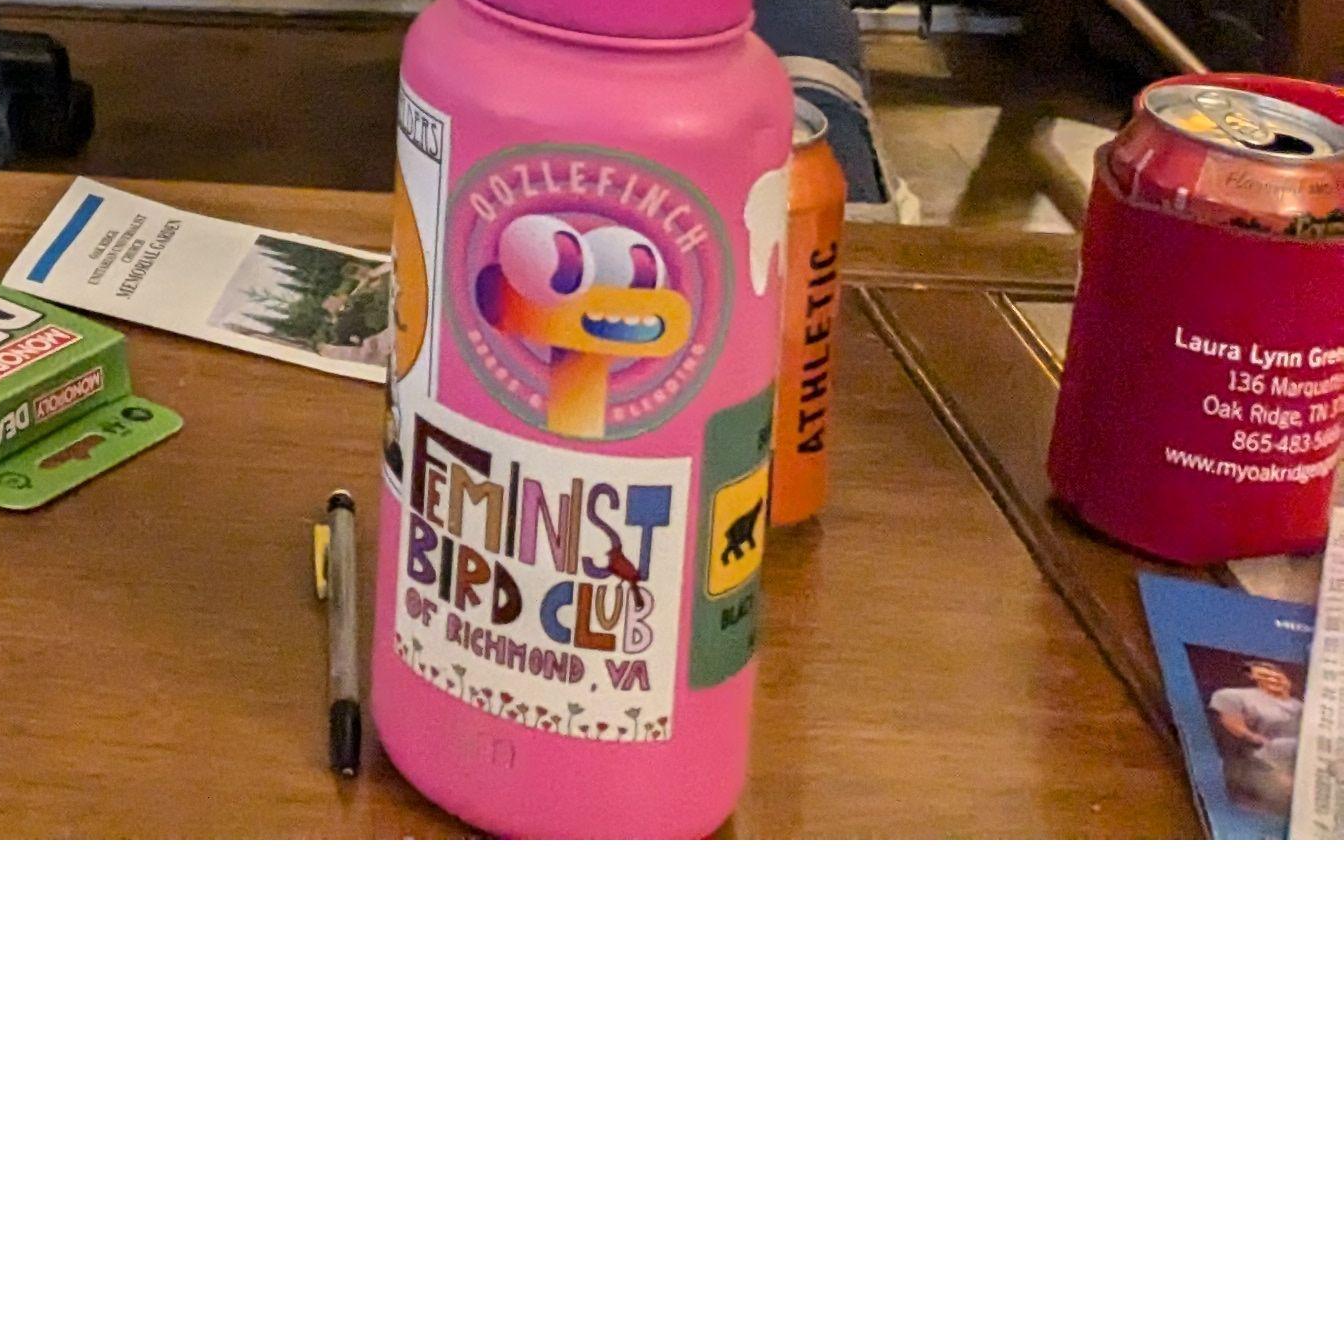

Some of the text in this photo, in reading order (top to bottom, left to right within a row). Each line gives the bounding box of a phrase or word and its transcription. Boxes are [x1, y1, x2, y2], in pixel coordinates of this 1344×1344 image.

[470, 162, 708, 254] OOZLEFINCH
[115, 218, 183, 299] MEMORIAL GARDEN
[796, 240, 838, 456] ATHLETIC
[1175, 325, 1242, 362] Laura
[1250, 342, 1303, 370] Lynn
[1227, 369, 1265, 395] 136
[36, 370, 102, 419] MONOPOLY
[1202, 393, 1244, 421] Oak
[410, 412, 673, 582] FEMINIST
[406, 511, 655, 654] BIRD CLUB
[405, 586, 438, 627] OF
[605, 659, 651, 691] VA
